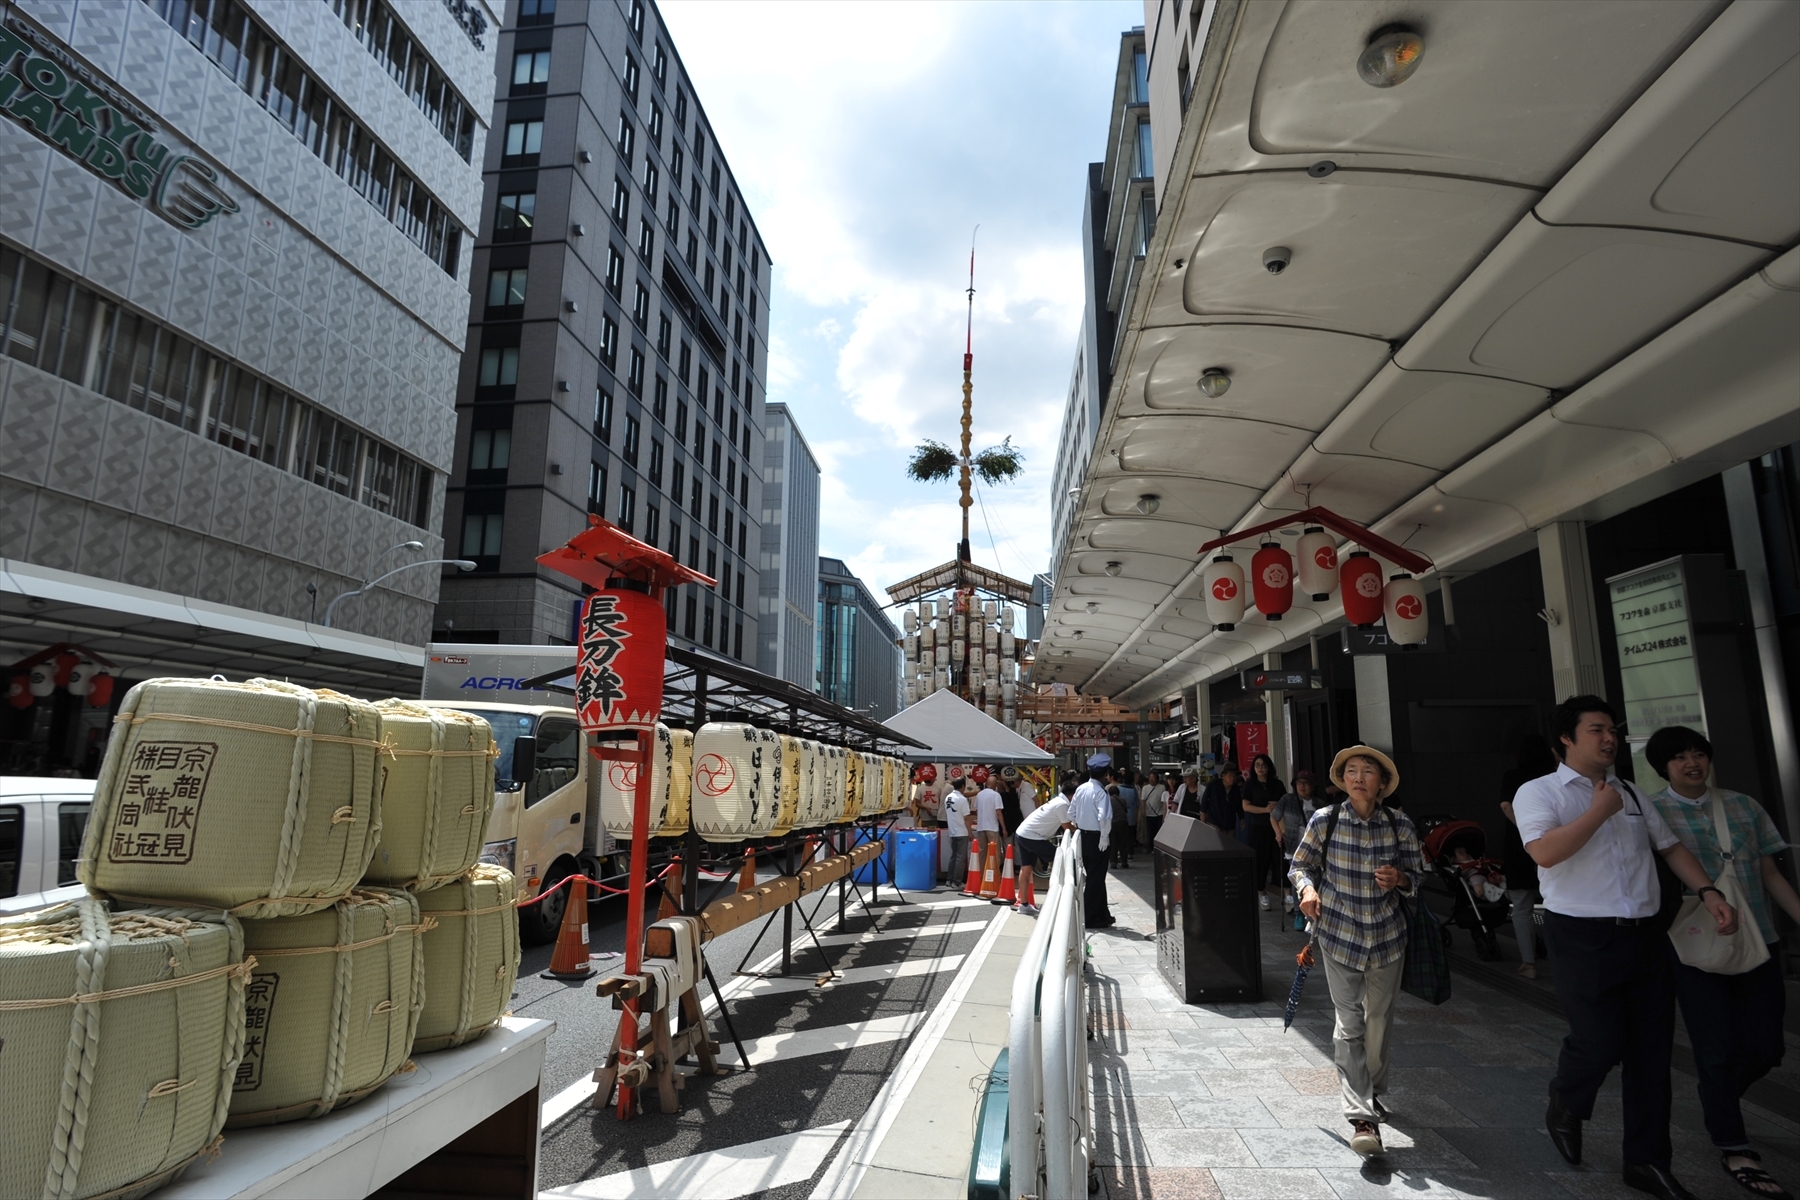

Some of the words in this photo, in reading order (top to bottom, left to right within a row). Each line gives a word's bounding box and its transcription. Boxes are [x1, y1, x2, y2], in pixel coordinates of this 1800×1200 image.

[0, 24, 171, 174] TOKYU
[14, 16, 91, 79] CREATIVE
[90, 73, 119, 101] LIFE
[119, 96, 161, 130] STORE
[576, 595, 632, 717] 長刀鉾
[1619, 606, 1651, 621] フコク生命
[1651, 598, 1683, 614] 京都支社
[1623, 640, 1658, 656] タイムズ24
[1658, 635, 1688, 650] 株式会社
[160, 746, 212, 858] 京都伏見
